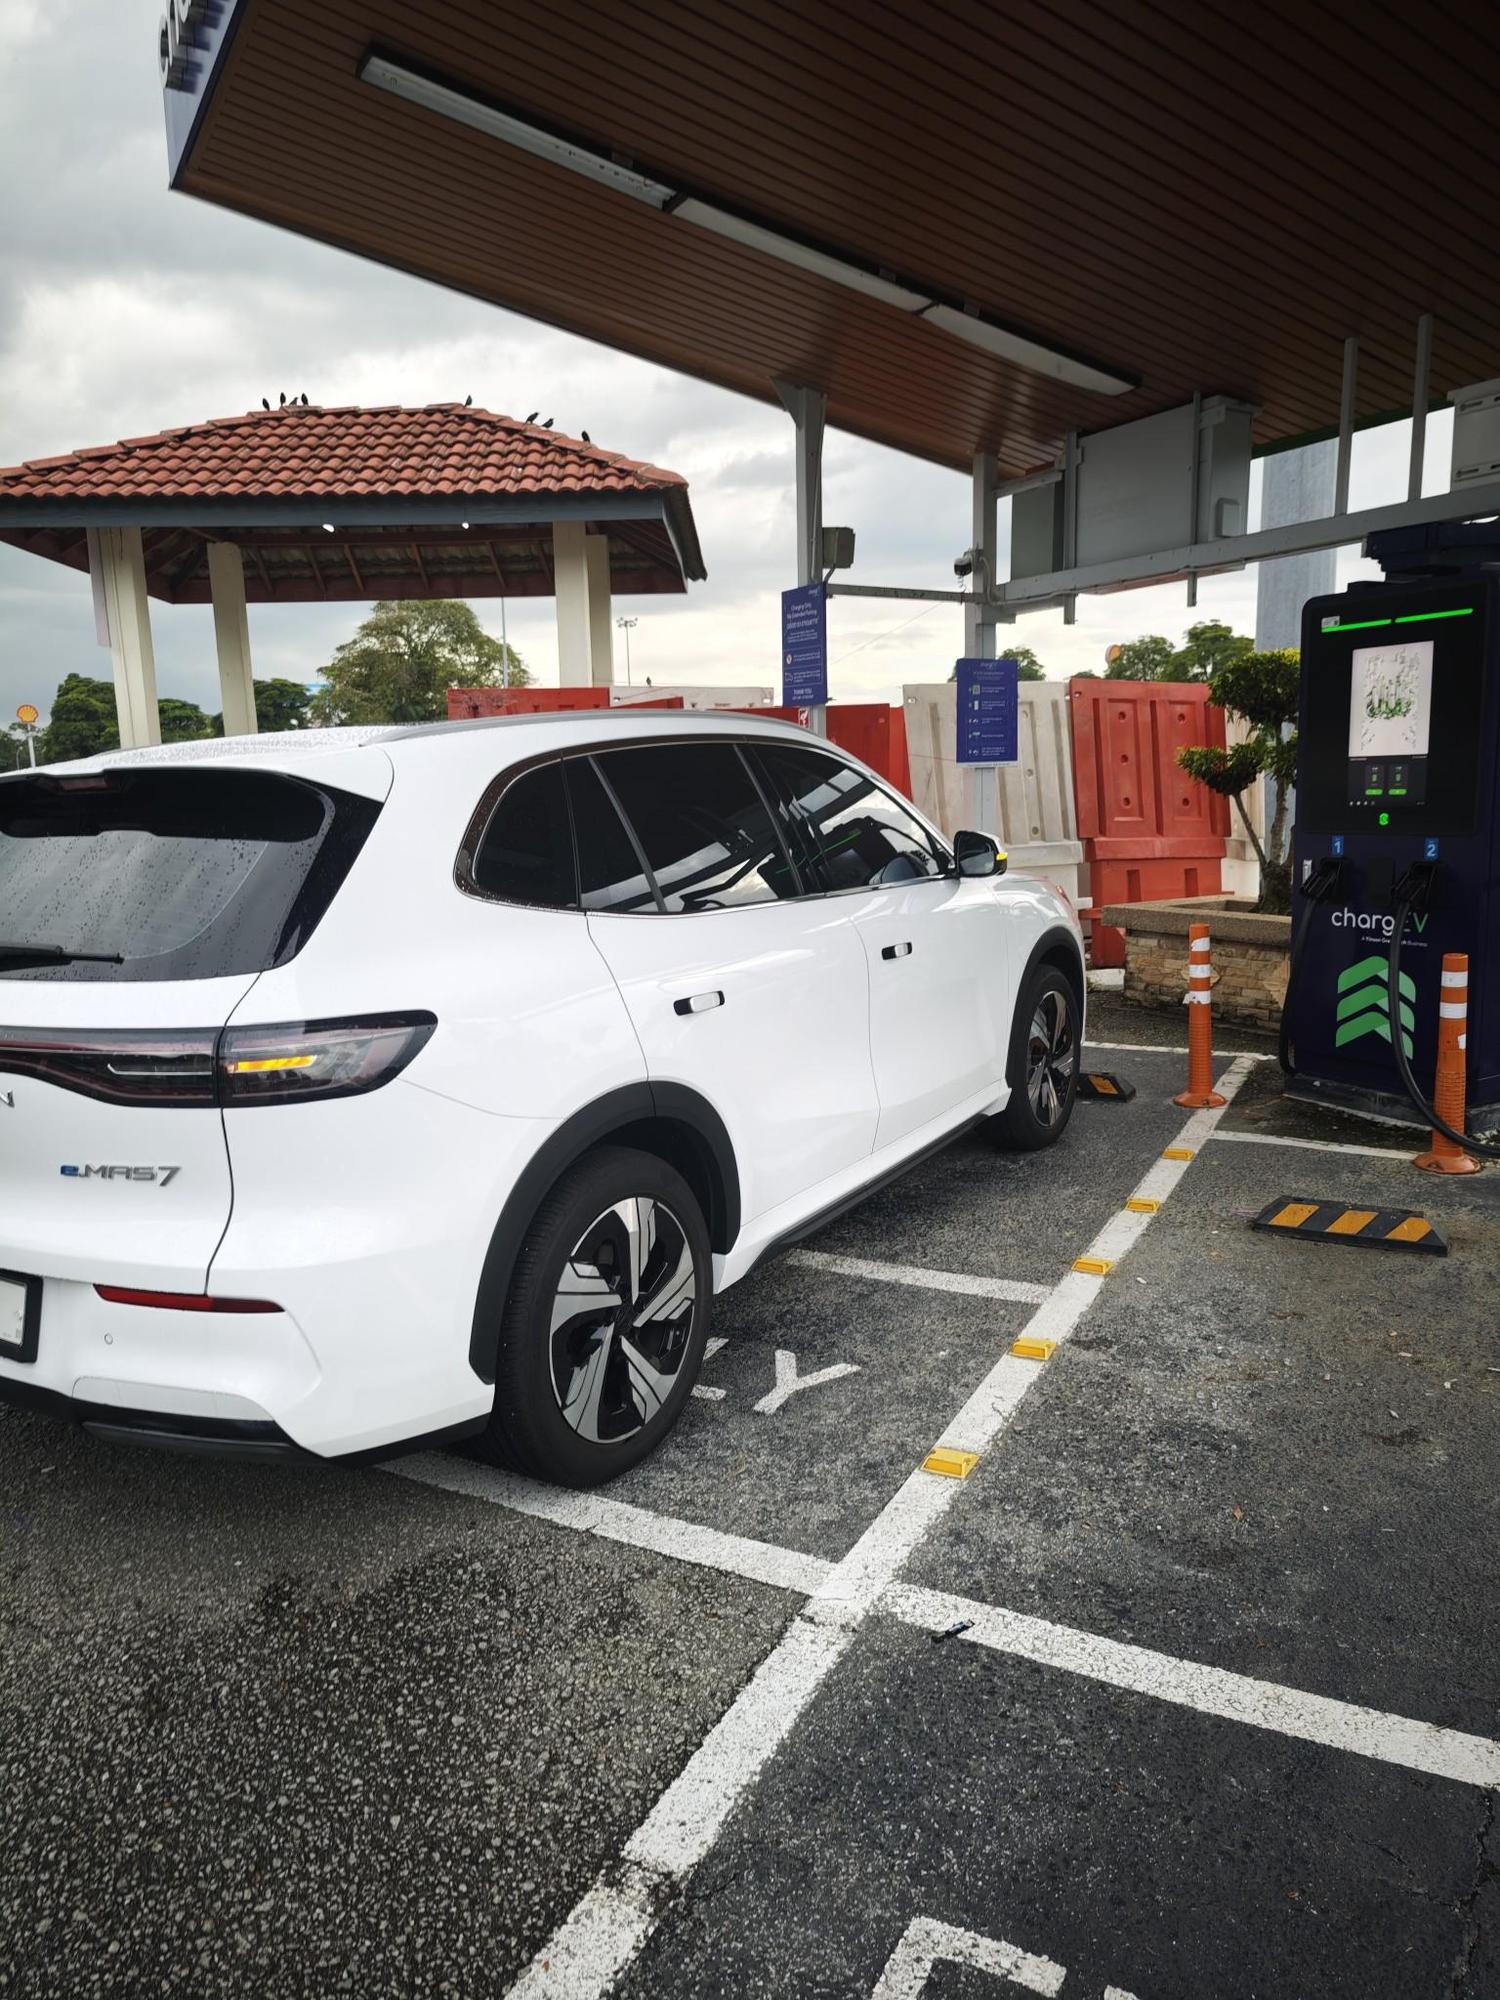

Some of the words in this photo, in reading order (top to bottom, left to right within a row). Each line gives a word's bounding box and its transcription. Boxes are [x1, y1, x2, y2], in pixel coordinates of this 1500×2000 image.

[1334, 841, 1341, 854] 1
[1426, 844, 1436, 857] 2
[1331, 907, 1429, 936] chargV
